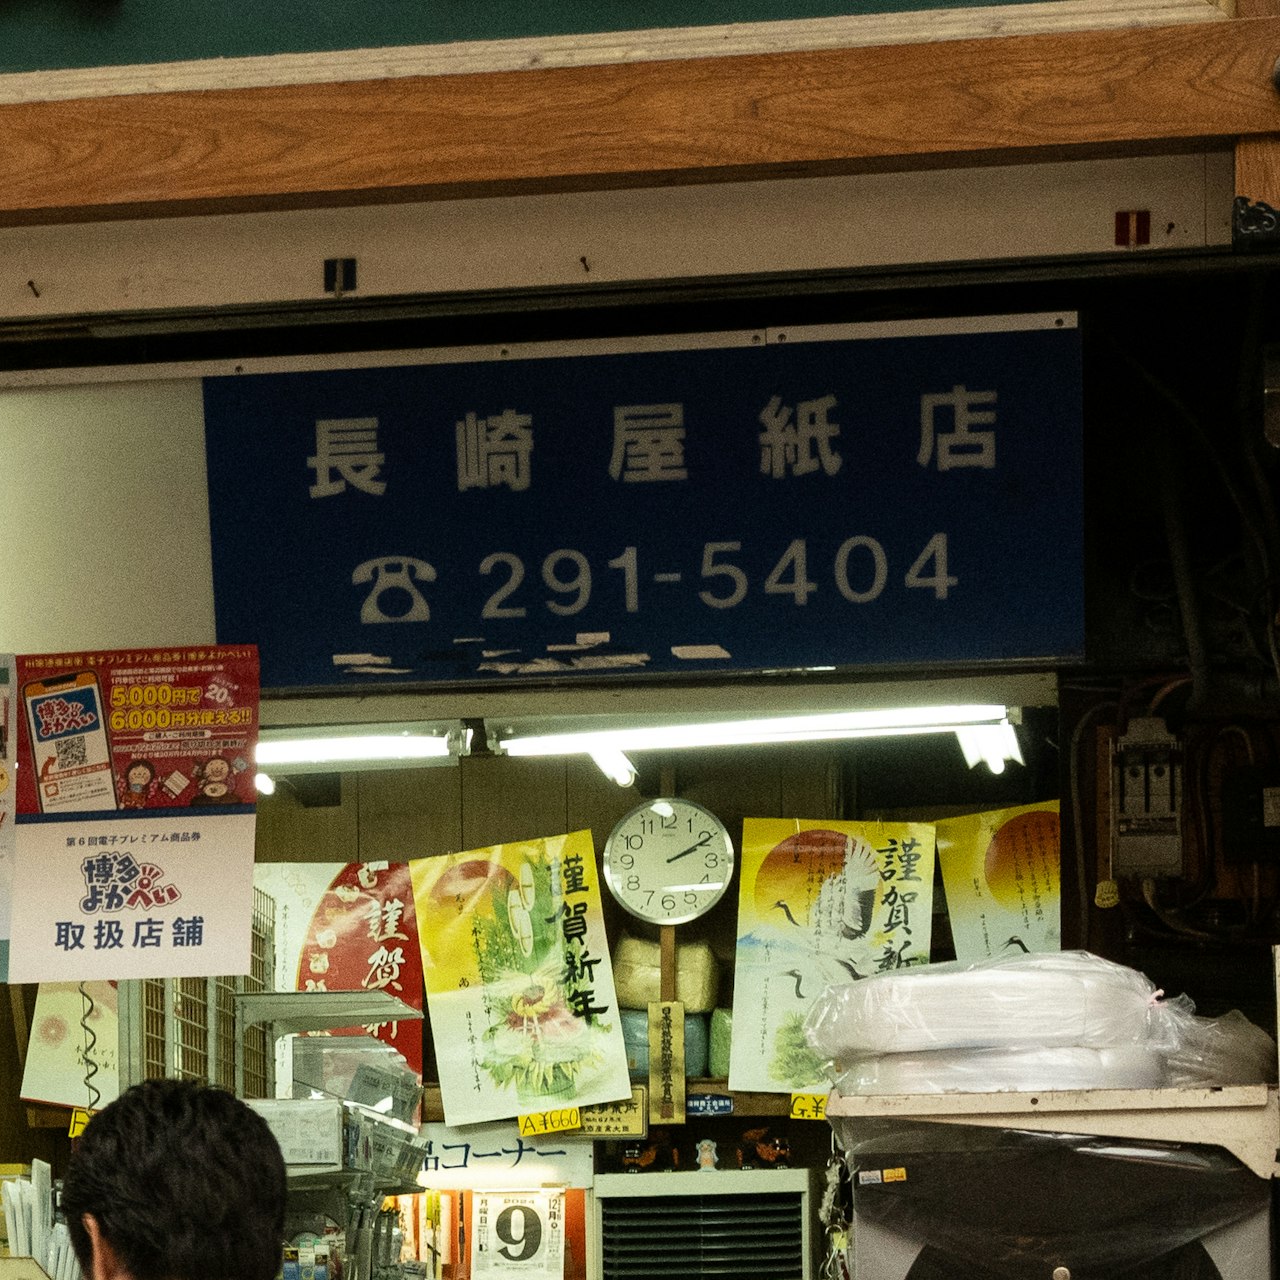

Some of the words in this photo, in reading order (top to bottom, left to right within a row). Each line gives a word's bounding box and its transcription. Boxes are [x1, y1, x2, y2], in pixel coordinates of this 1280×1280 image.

[307, 384, 1000, 500] 長崎屋紙店
[478, 531, 959, 620] 291-5404
[642, 820, 655, 834] 11
[660, 813, 677, 829] 12
[686, 819, 693, 833] 1
[624, 834, 643, 850] 10
[84, 854, 140, 883] 博多
[621, 854, 634, 869] 9
[705, 854, 718, 868] 3
[627, 876, 640, 890] 8
[644, 890, 656, 905] 7
[662, 894, 676, 909] 6
[684, 889, 697, 903] 5
[55, 916, 204, 951] 取扱店舗
[545, 854, 609, 1026] 謹賀新年
[496, 1206, 542, 1261] 9
